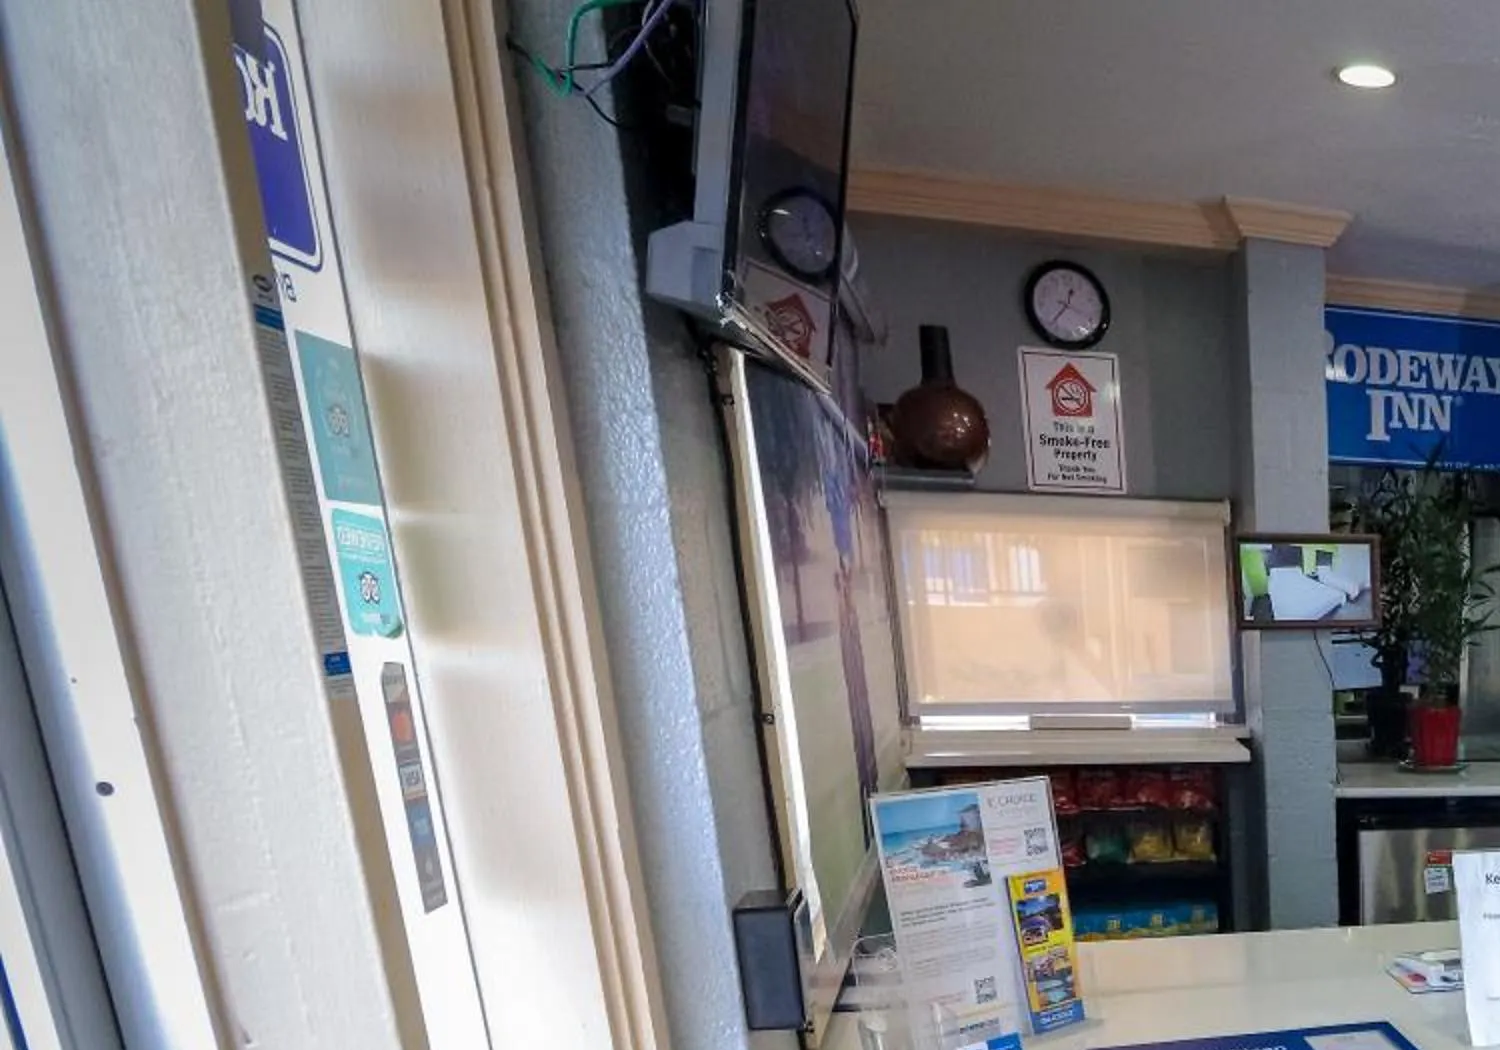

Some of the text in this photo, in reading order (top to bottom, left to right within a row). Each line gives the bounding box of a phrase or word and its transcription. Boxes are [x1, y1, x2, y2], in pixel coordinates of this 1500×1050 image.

[1365, 389, 1453, 442] INN
[1040, 433, 1111, 449] Smoke-Free
[1054, 448, 1098, 461] Property
